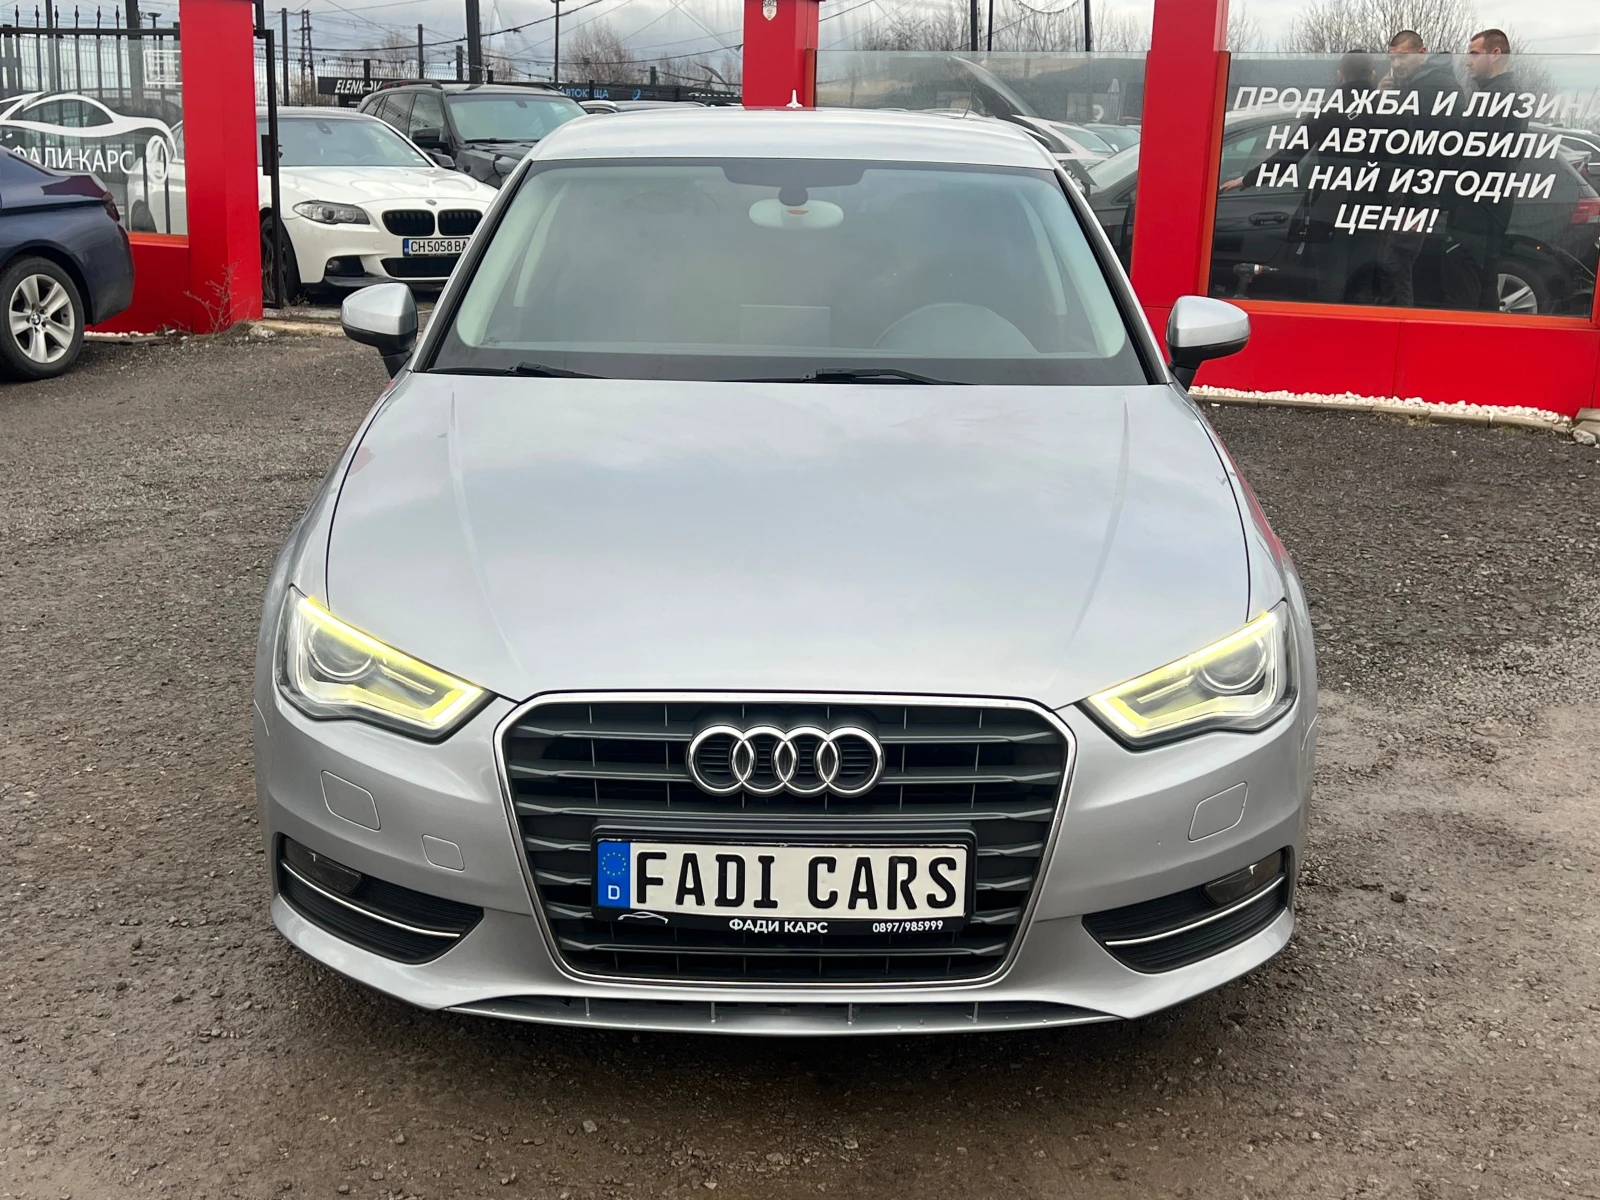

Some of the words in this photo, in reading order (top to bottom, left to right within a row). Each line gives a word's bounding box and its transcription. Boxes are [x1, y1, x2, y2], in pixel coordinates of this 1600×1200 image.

[1233, 87, 1420, 119] ПРОДАЖБА
[1431, 91, 1459, 117] И
[1265, 125, 1310, 150] НА
[1318, 127, 1563, 160] АВТОМОБИЛИ
[79, 148, 133, 174] КАРС
[1256, 163, 1299, 188] НА
[1308, 162, 1380, 192] НАЙ
[1388, 168, 1556, 203] ИЗГОДНИ
[1334, 203, 1440, 235] ЦЕНИ!
[607, 885, 621, 900] D
[636, 851, 778, 909] FADI
[808, 856, 957, 911] CARS
[729, 918, 780, 934] ФАДИ
[784, 920, 829, 934] КАРС
[872, 920, 944, 933] 0897/985999
